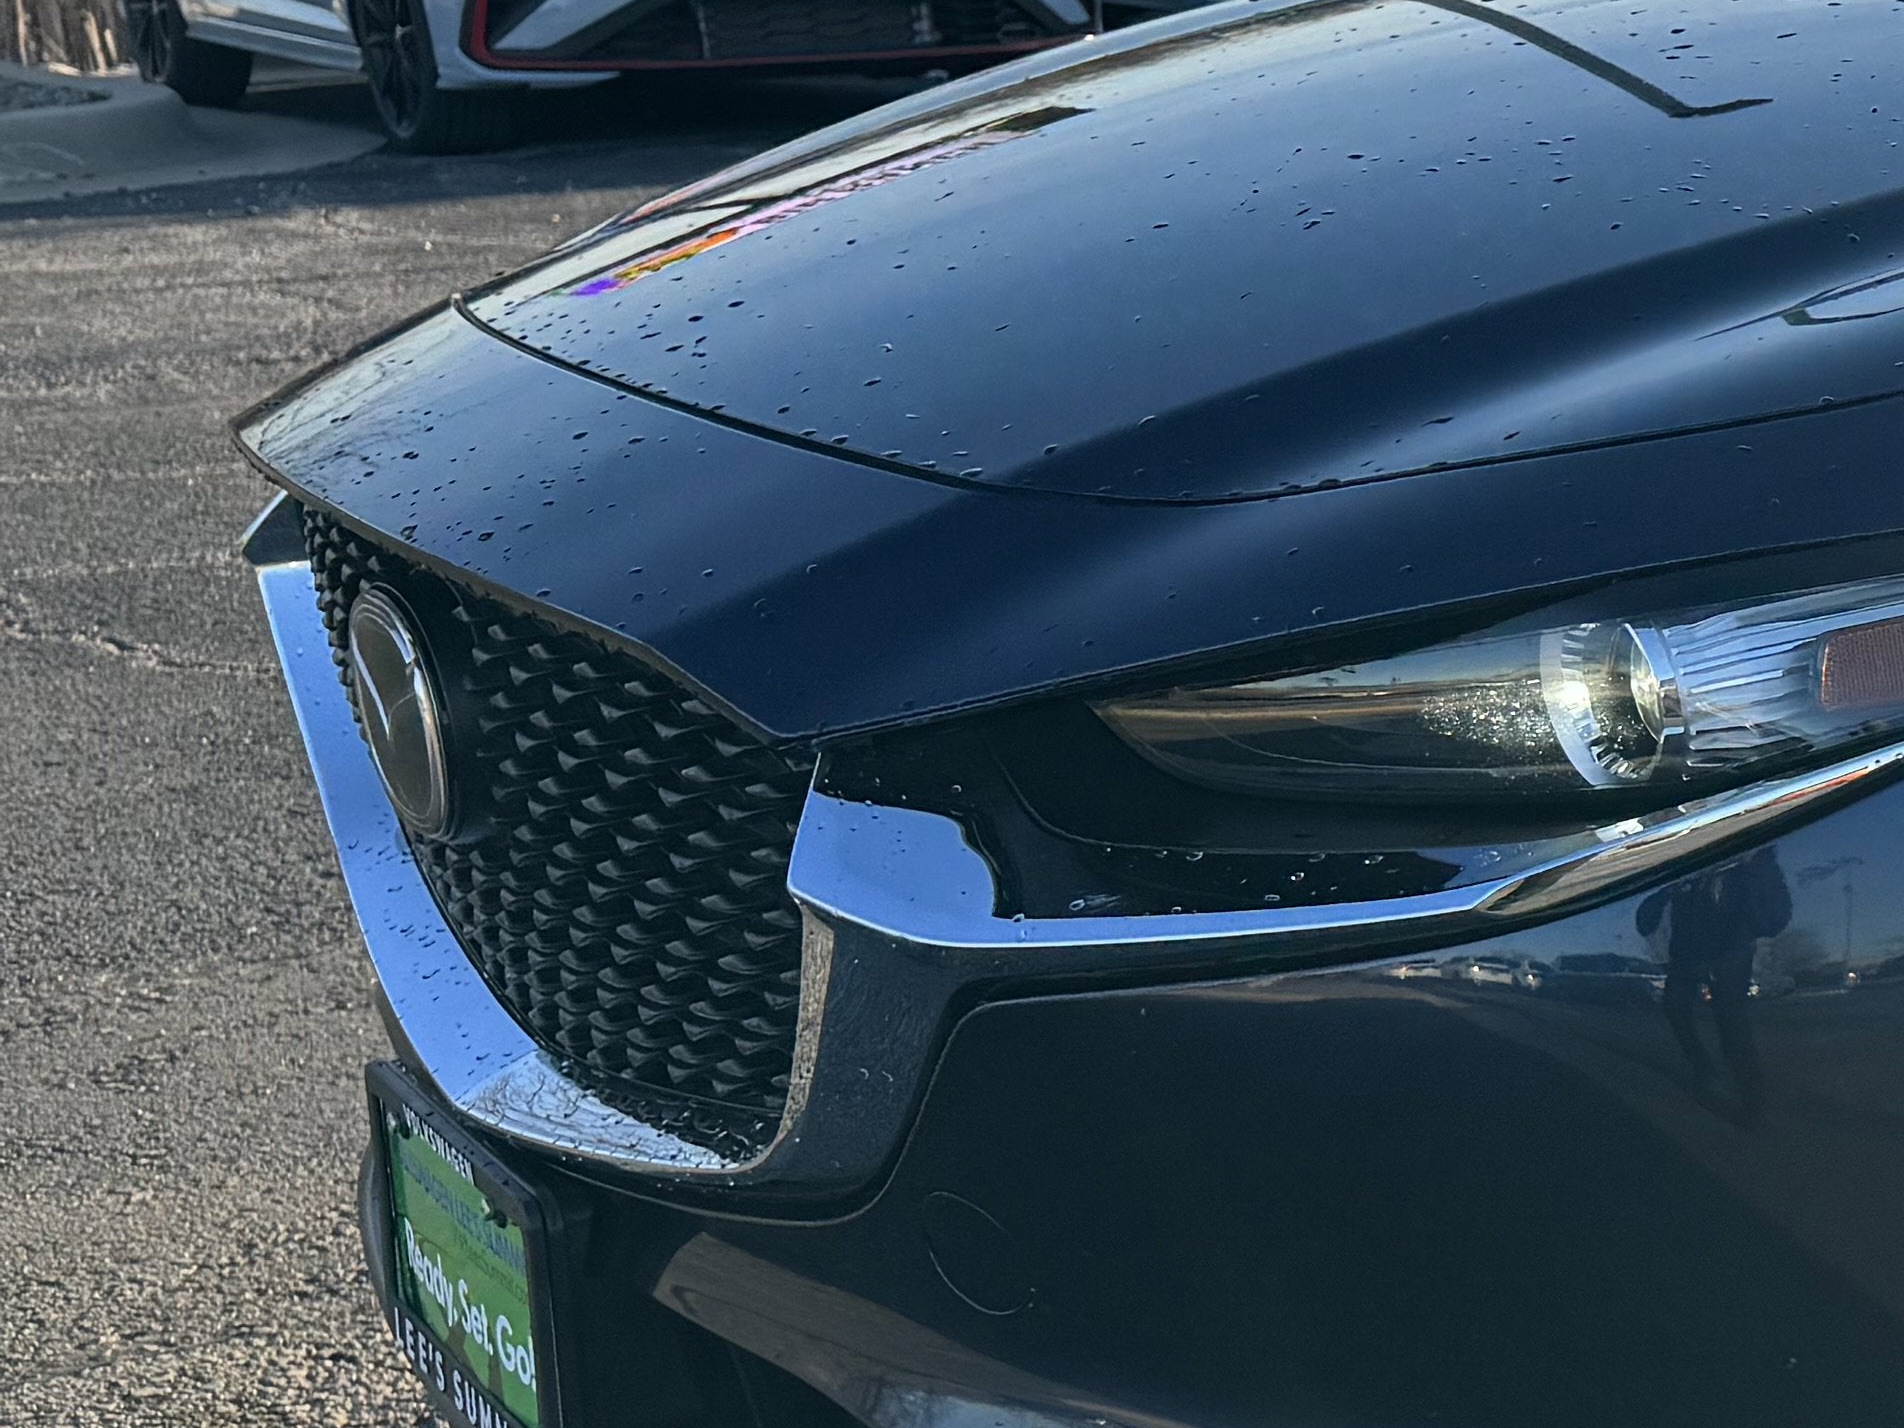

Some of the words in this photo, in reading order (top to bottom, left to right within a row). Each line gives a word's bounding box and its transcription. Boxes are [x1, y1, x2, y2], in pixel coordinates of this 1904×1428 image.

[402, 1102, 476, 1187] VOLKSWAGEN
[394, 1307, 446, 1392] LEE'S
[458, 1279, 494, 1357] Set.
[496, 1315, 537, 1393] Go!
